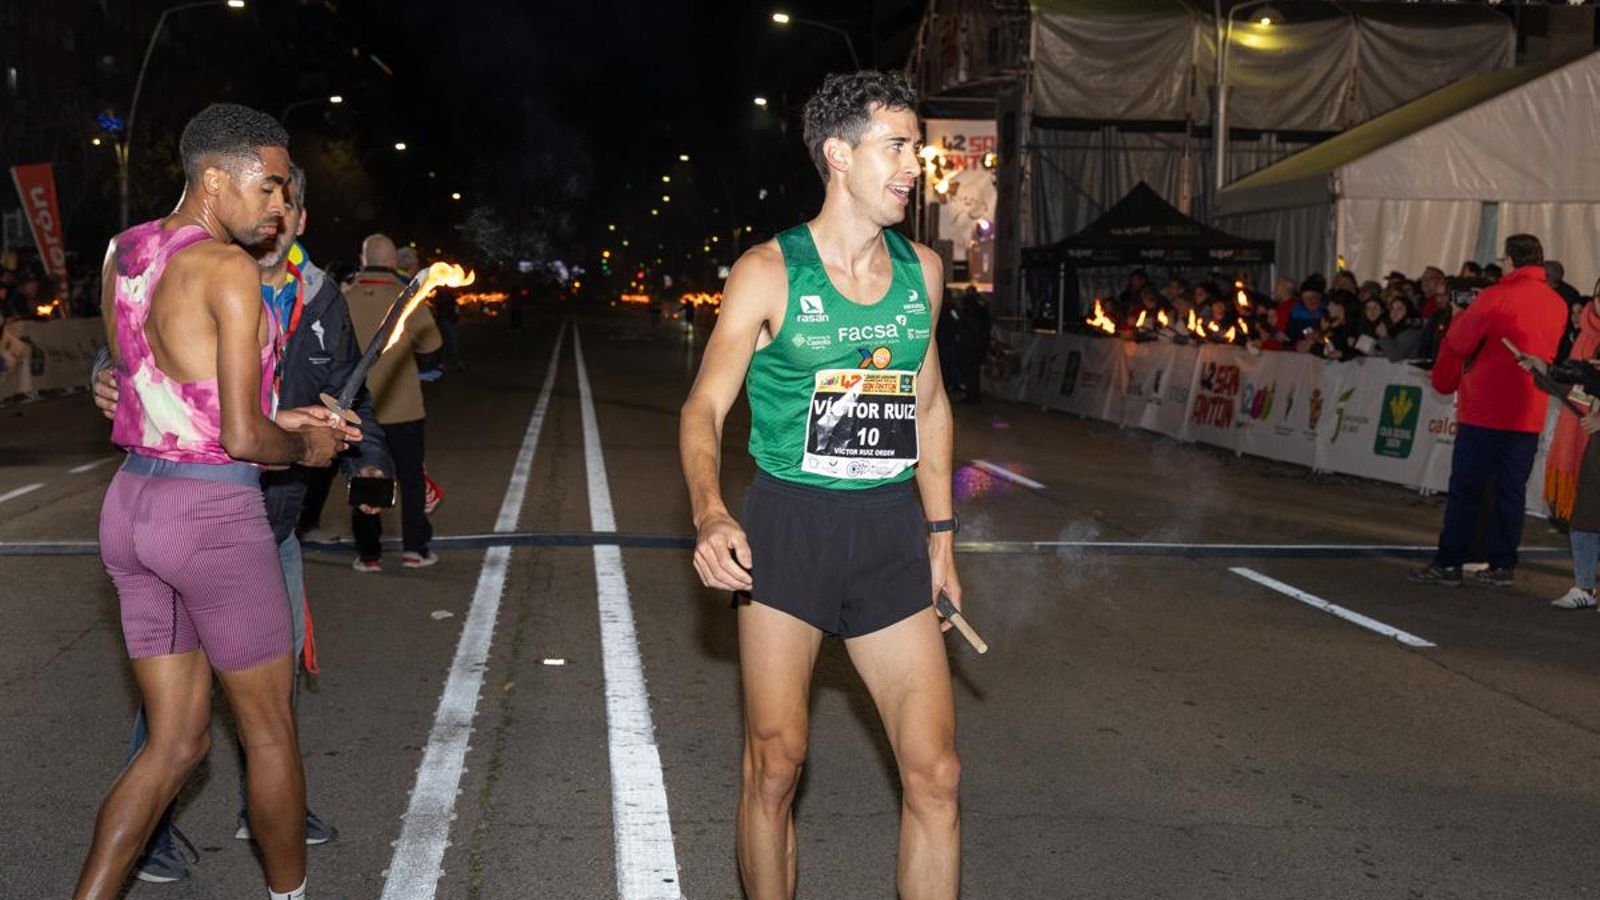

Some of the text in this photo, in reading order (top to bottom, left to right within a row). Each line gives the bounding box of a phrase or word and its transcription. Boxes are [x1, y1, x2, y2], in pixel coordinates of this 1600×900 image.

[942, 134, 966, 150] 42
[884, 403, 916, 420] RUIZ
[857, 427, 880, 446] 10
